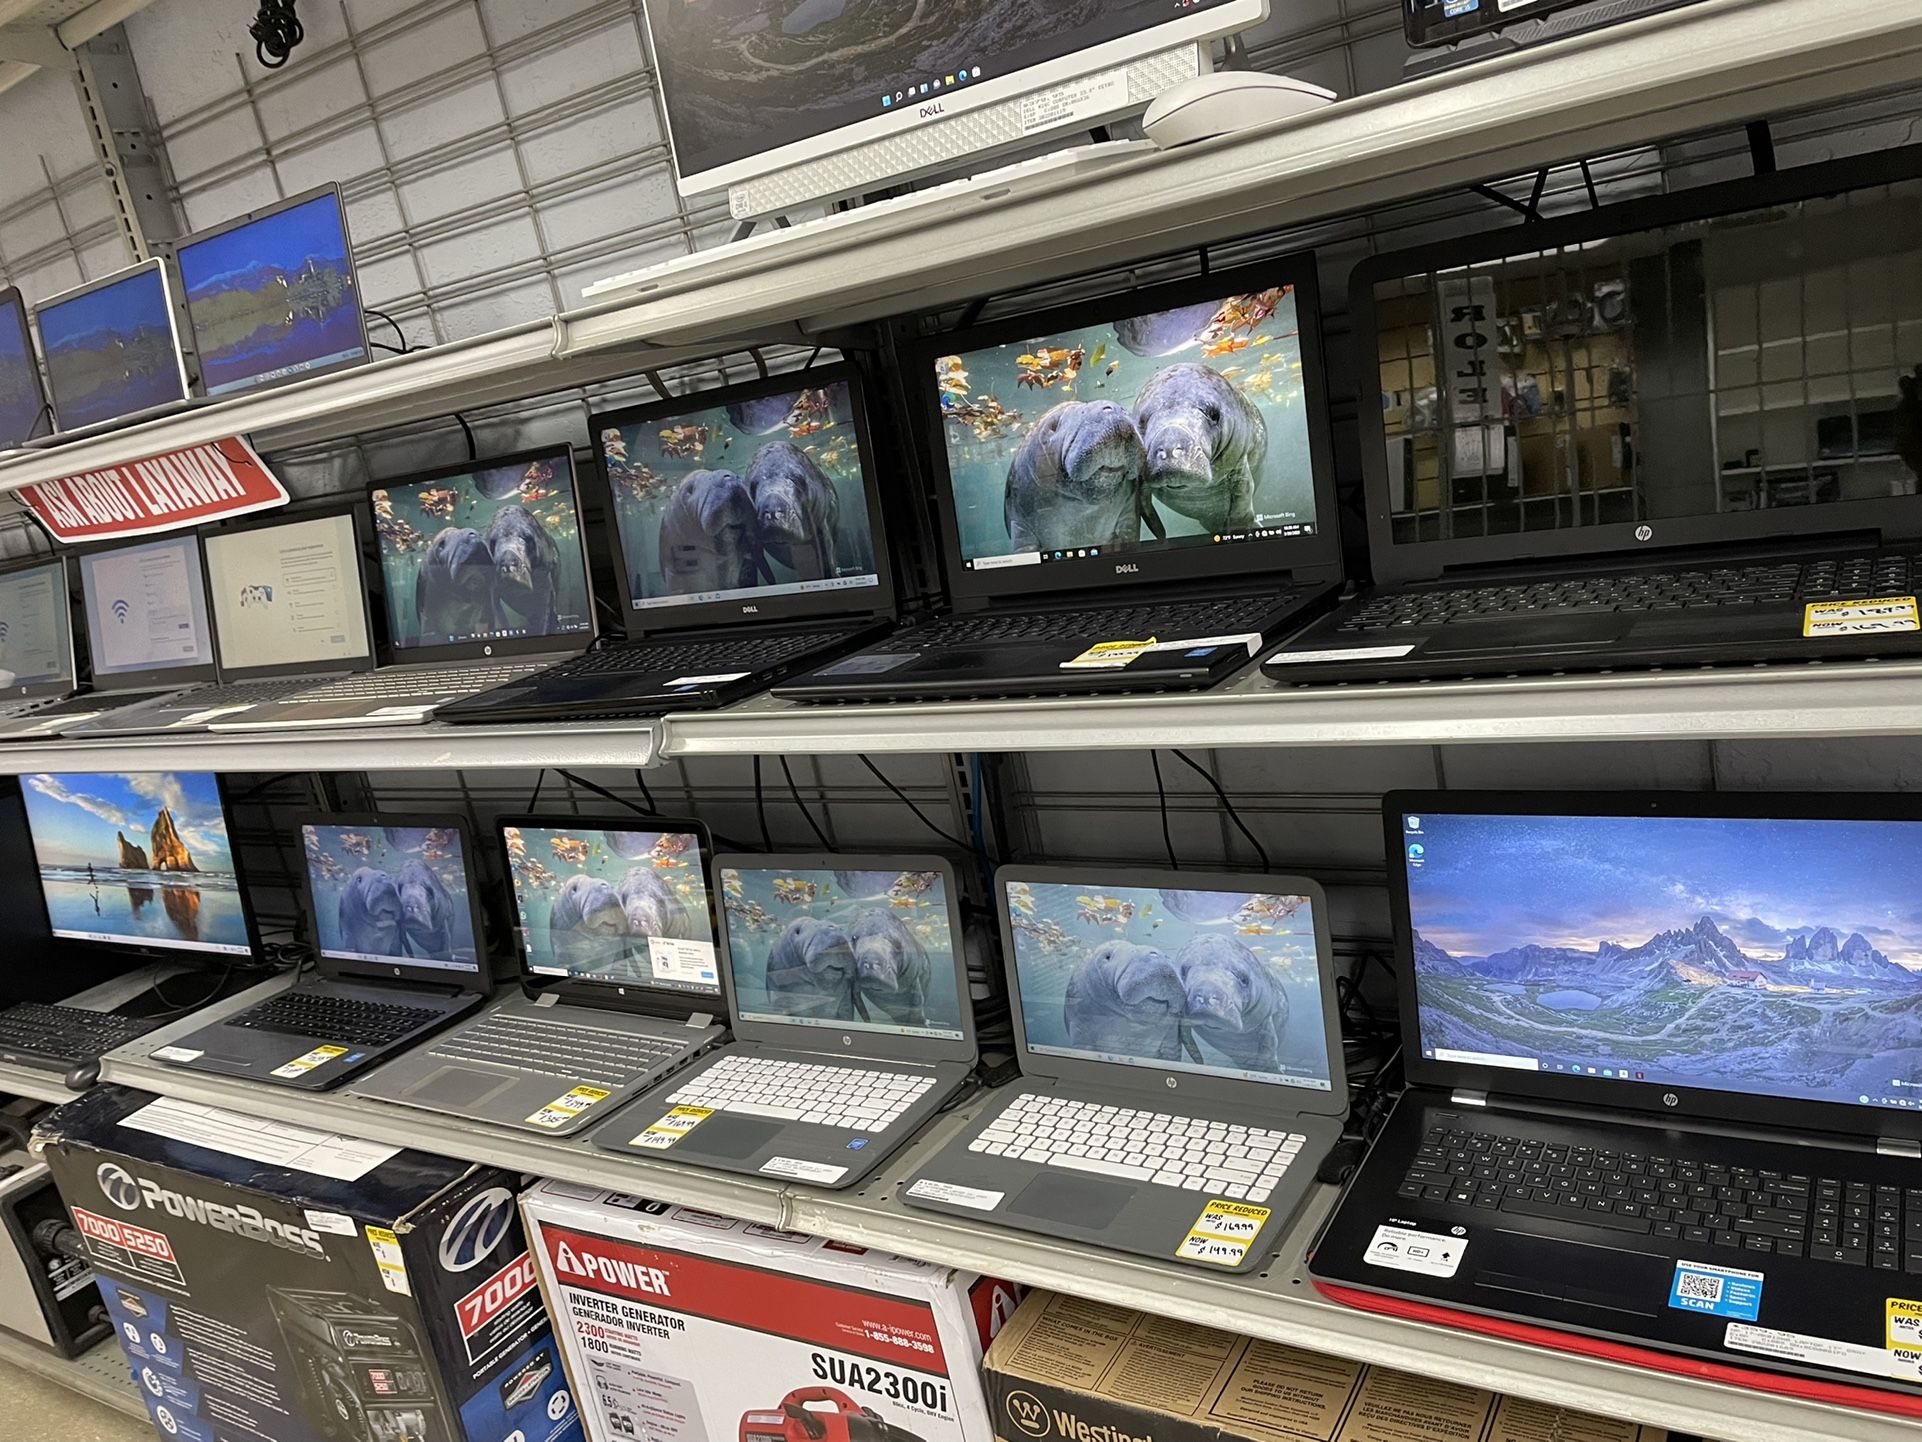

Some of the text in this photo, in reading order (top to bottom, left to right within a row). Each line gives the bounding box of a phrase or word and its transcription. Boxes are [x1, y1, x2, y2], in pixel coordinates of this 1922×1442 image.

[920, 103, 944, 118] DELL
[32, 443, 246, 529] ASK ABOUT LAYAWAY
[1635, 525, 1652, 542] hp
[1115, 564, 1139, 574] DELL
[742, 605, 758, 614] DELL
[1166, 1076, 1177, 1088] hp
[1664, 1093, 1678, 1107] hp
[1205, 1212, 1224, 1221] WAS
[1210, 1201, 1268, 1216] PRICE REDUCED
[1215, 1221, 1254, 1231] $ 169.99
[77, 1213, 120, 1242] 7000
[123, 1227, 169, 1257] 5250
[1189, 1236, 1208, 1244] NOW
[1198, 1245, 1243, 1257] $ 149.99
[1709, 1266, 1747, 1277] SMARTPHONE
[1728, 1298, 1753, 1307] Support
[1729, 1290, 1756, 1298] Features
[569, 1292, 686, 1332] INVERTER GENERATOR
[1680, 1297, 1715, 1310] SCAN
[572, 1306, 671, 1340] GENERADOR INVERTER
[1042, 1316, 1062, 1326] WHAT
[1061, 1321, 1083, 1332] COMES
[1091, 1330, 1103, 1339] THE
[1104, 1334, 1119, 1342] BOX
[1894, 1315, 1921, 1327] WAS
[576, 1321, 605, 1339] 2300
[861, 1319, 932, 1342] www.a-ipower.com
[580, 1336, 609, 1354] 1800
[864, 1329, 935, 1354] 1-855-888-3598
[472, 1331, 528, 1380] PORTABLE GENERATOR
[1138, 1342, 1186, 1359] AVERTISSEMENT
[1893, 1349, 1922, 1360] NOW
[811, 1352, 947, 1413] SUA2300i
[1253, 1379, 1276, 1387] PLEASE
[1299, 1388, 1324, 1398] RETURN
[1252, 1384, 1273, 1392] GOODS
[1292, 1392, 1320, 1402] WITHOUT
[1254, 1389, 1281, 1399] SHIPPING
[1282, 1395, 1326, 1410] INSTRUCTIONS.
[1364, 1401, 1392, 1411] VEUILLEZ
[1392, 1406, 1401, 1414] NE
[1415, 1411, 1433, 1420] NOUS
[1433, 1414, 1472, 1429] RETOURNER
[1375, 1408, 1422, 1423] MARCHANDISES
[1423, 1418, 1444, 1427] AVANT
[1389, 1417, 1425, 1430] DIRECTIVES
